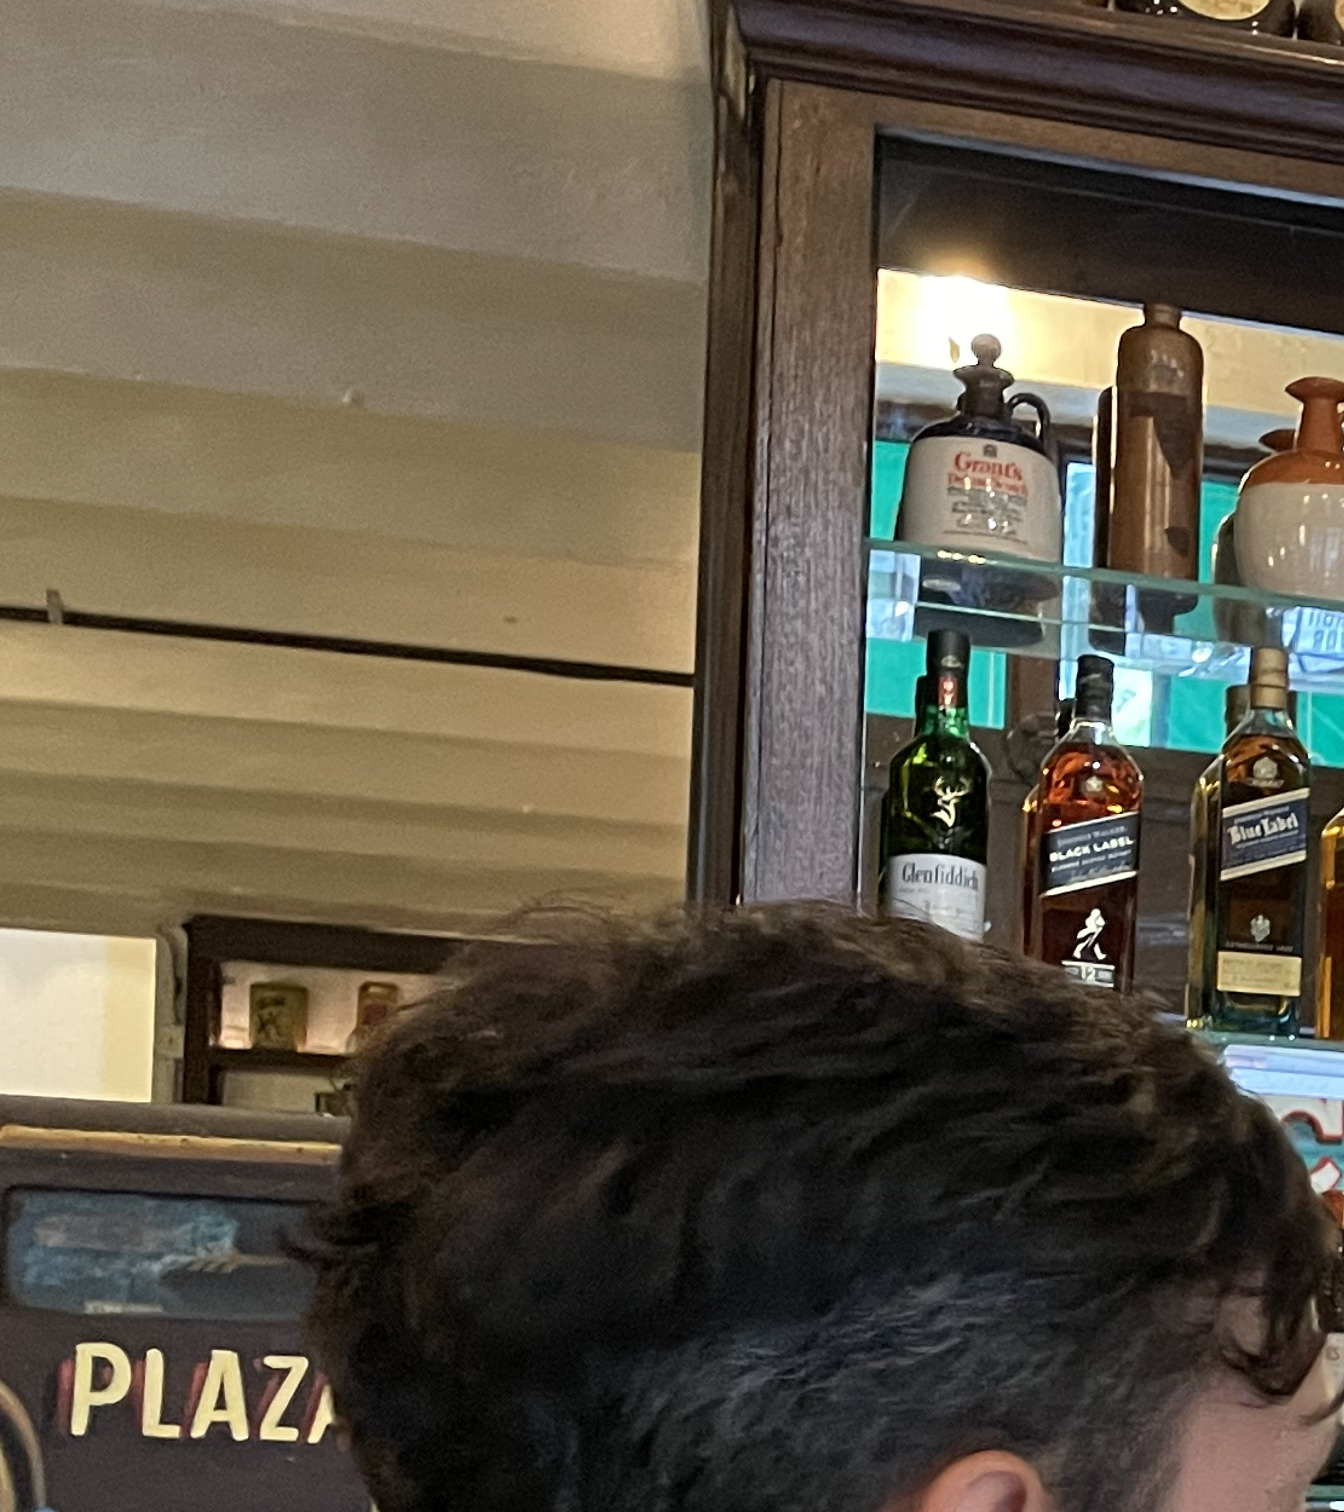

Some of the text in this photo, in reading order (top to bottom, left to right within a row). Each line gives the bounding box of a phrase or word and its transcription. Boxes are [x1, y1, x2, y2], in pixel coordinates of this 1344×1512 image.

[1226, 824, 1262, 846] Blue
[1260, 812, 1299, 838] Label
[1049, 843, 1091, 863] BLACK
[1092, 835, 1134, 853] LABEL
[902, 861, 979, 892] Glenfiddich
